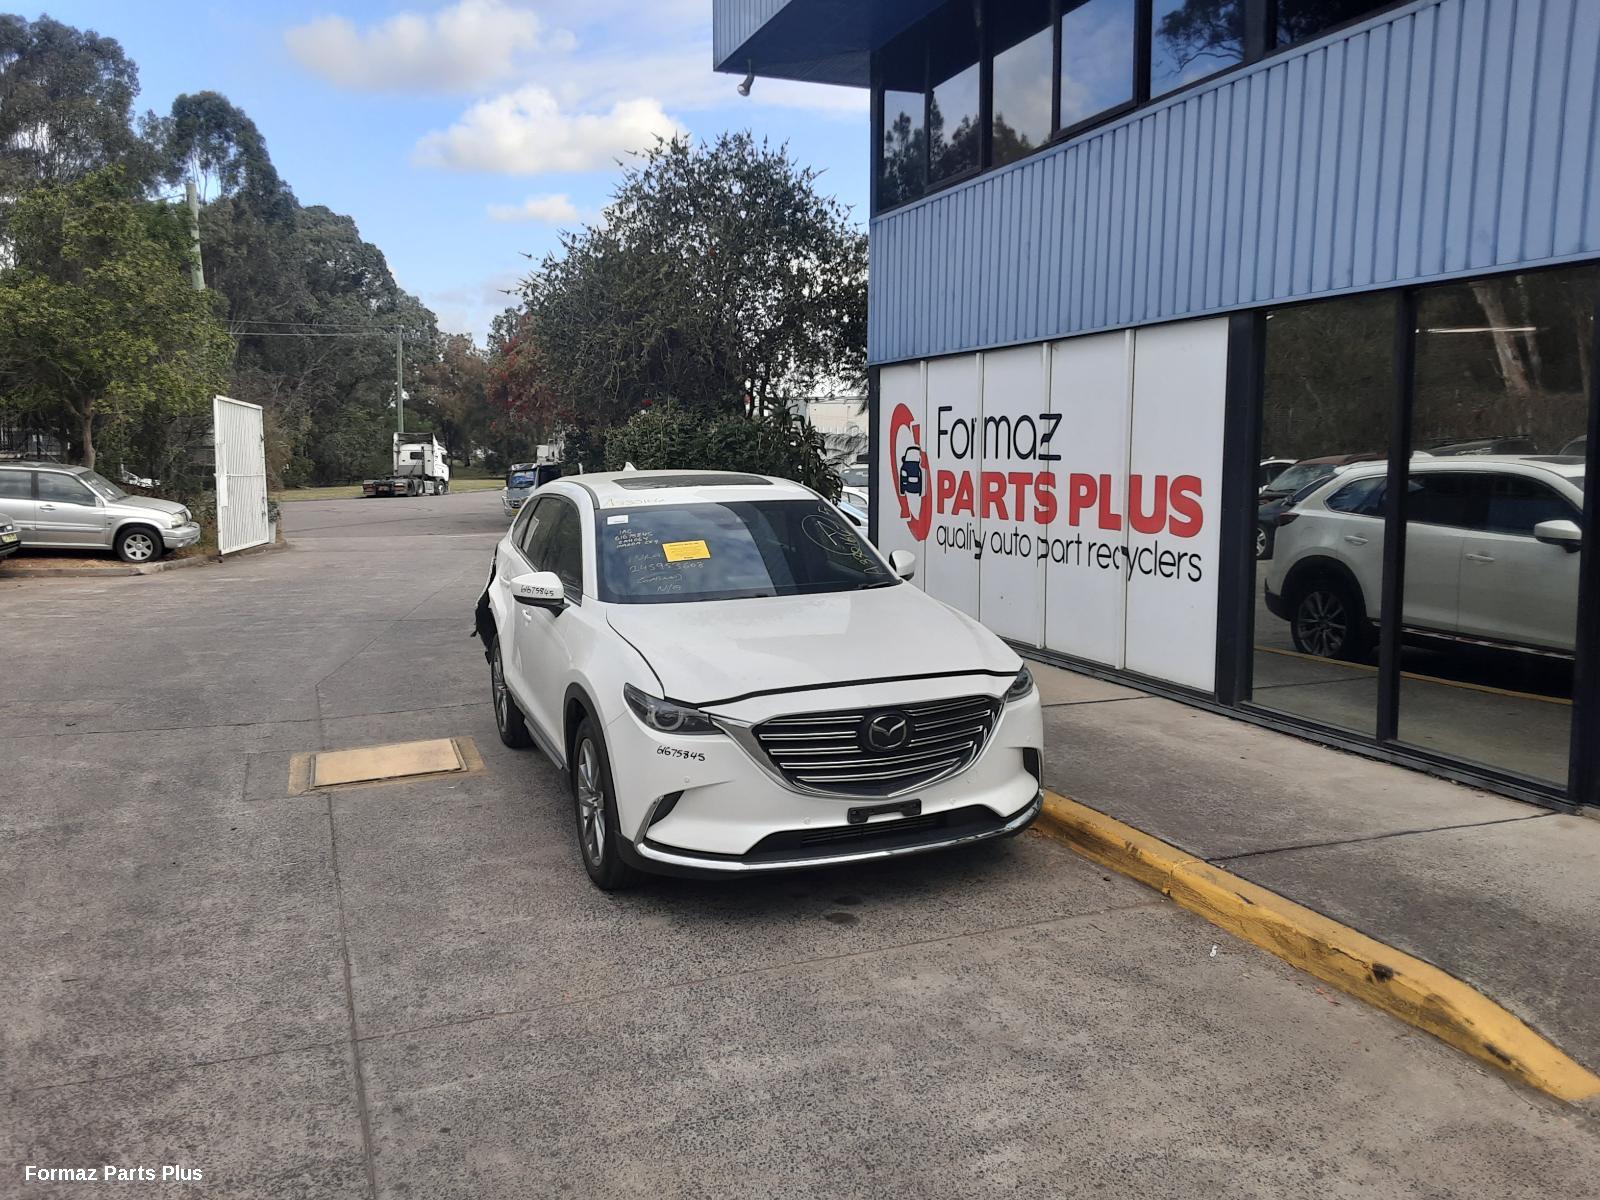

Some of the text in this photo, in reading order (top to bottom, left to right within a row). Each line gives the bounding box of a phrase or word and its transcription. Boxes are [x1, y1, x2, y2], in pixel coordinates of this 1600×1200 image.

[938, 405, 1062, 461] Formaz
[937, 469, 1204, 538] PARTS PLUS
[990, 525, 1032, 557] auto
[1036, 532, 1082, 569] part
[1088, 540, 1203, 582] recyclers
[656, 745, 706, 761] 61675845
